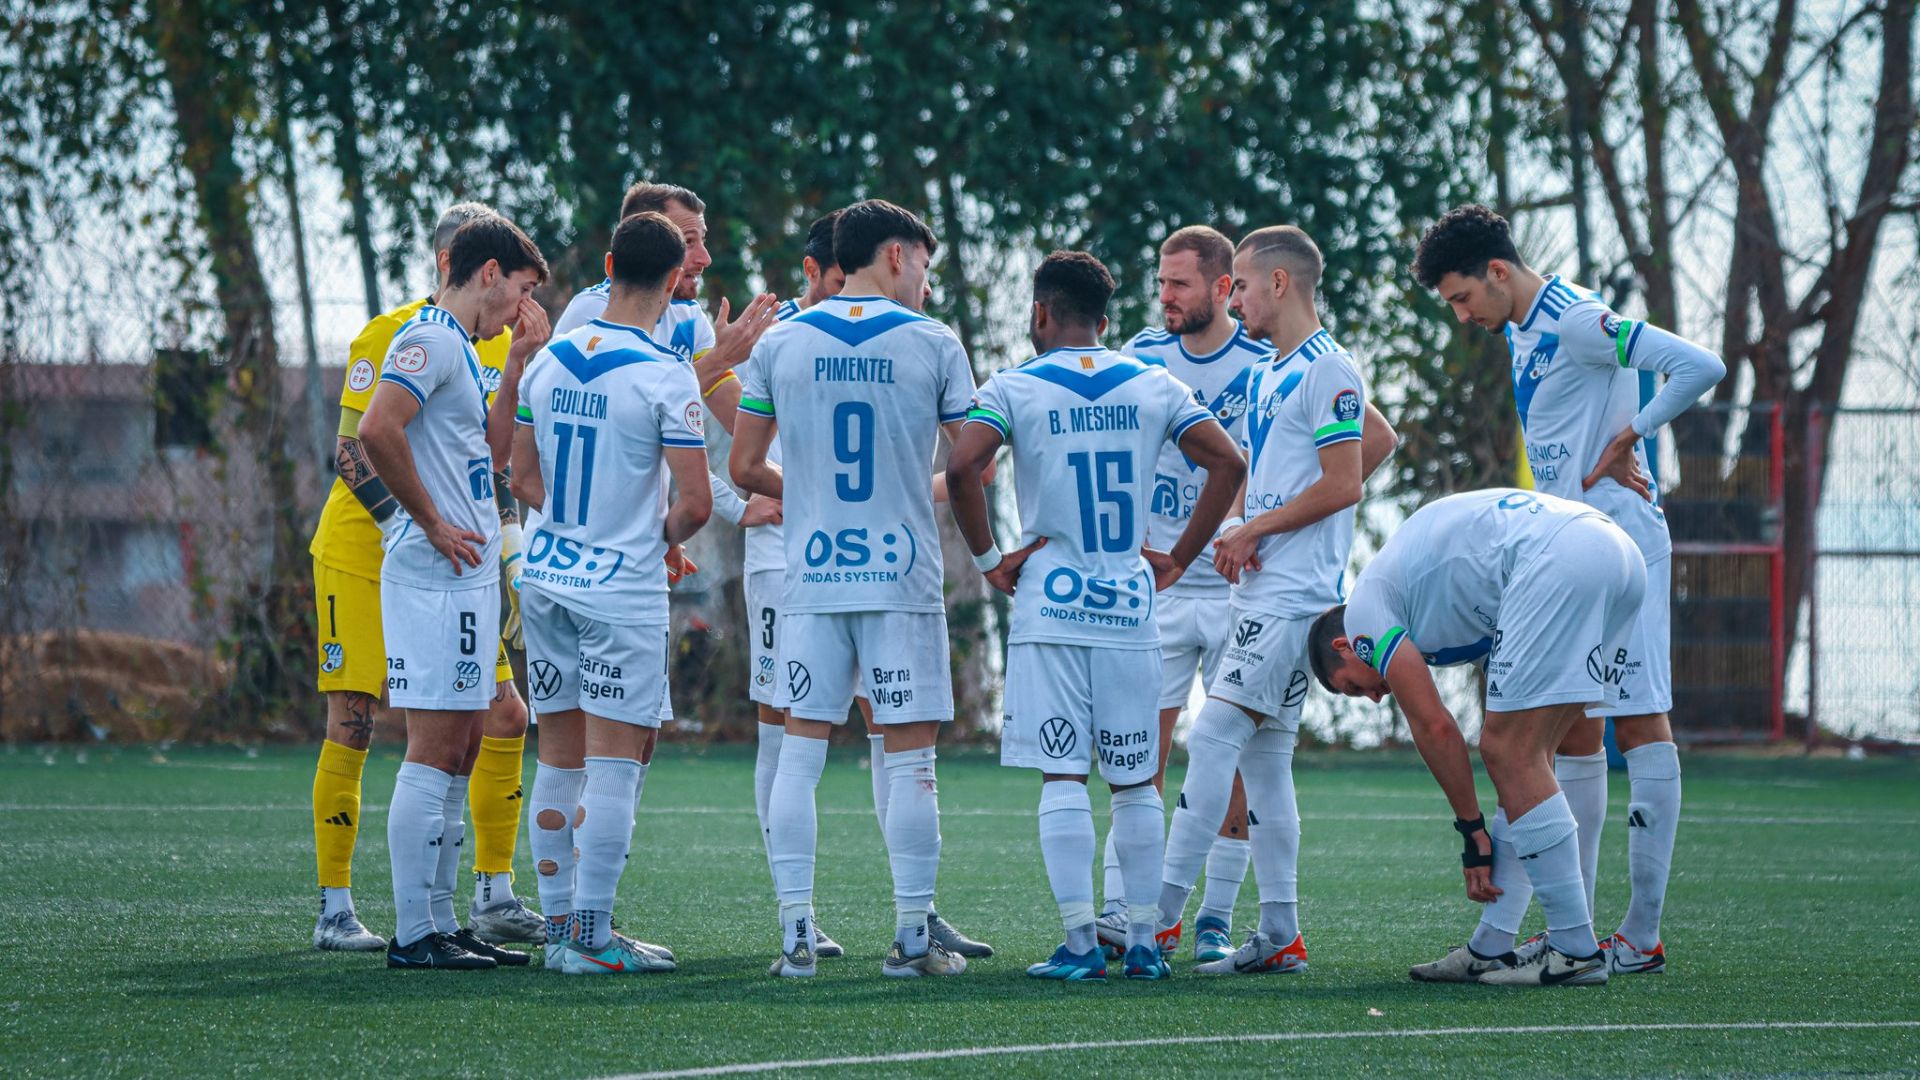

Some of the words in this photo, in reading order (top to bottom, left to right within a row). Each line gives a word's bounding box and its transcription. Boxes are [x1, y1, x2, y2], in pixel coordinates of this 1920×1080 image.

[815, 357, 895, 384] PIMENTEL
[552, 387, 607, 420] GUILLEM
[1339, 400, 1357, 412] NO
[1049, 409, 1067, 435] B.
[1070, 404, 1140, 433] MESHAK
[833, 401, 875, 504] 9
[552, 422, 598, 527] 11
[1067, 450, 1134, 554] 15
[548, 573, 592, 589] SYSTEM
[802, 572, 841, 583] ONDAS
[844, 571, 898, 583] SYSTEM
[328, 594, 336, 638] 1
[761, 607, 776, 650] 3
[1040, 606, 1085, 622] ONDAS
[1088, 611, 1139, 628] SYSTEM
[459, 611, 476, 655] 5
[873, 667, 910, 684] Barna
[1100, 729, 1148, 747] Barna
[1097, 745, 1149, 770] Wagen
